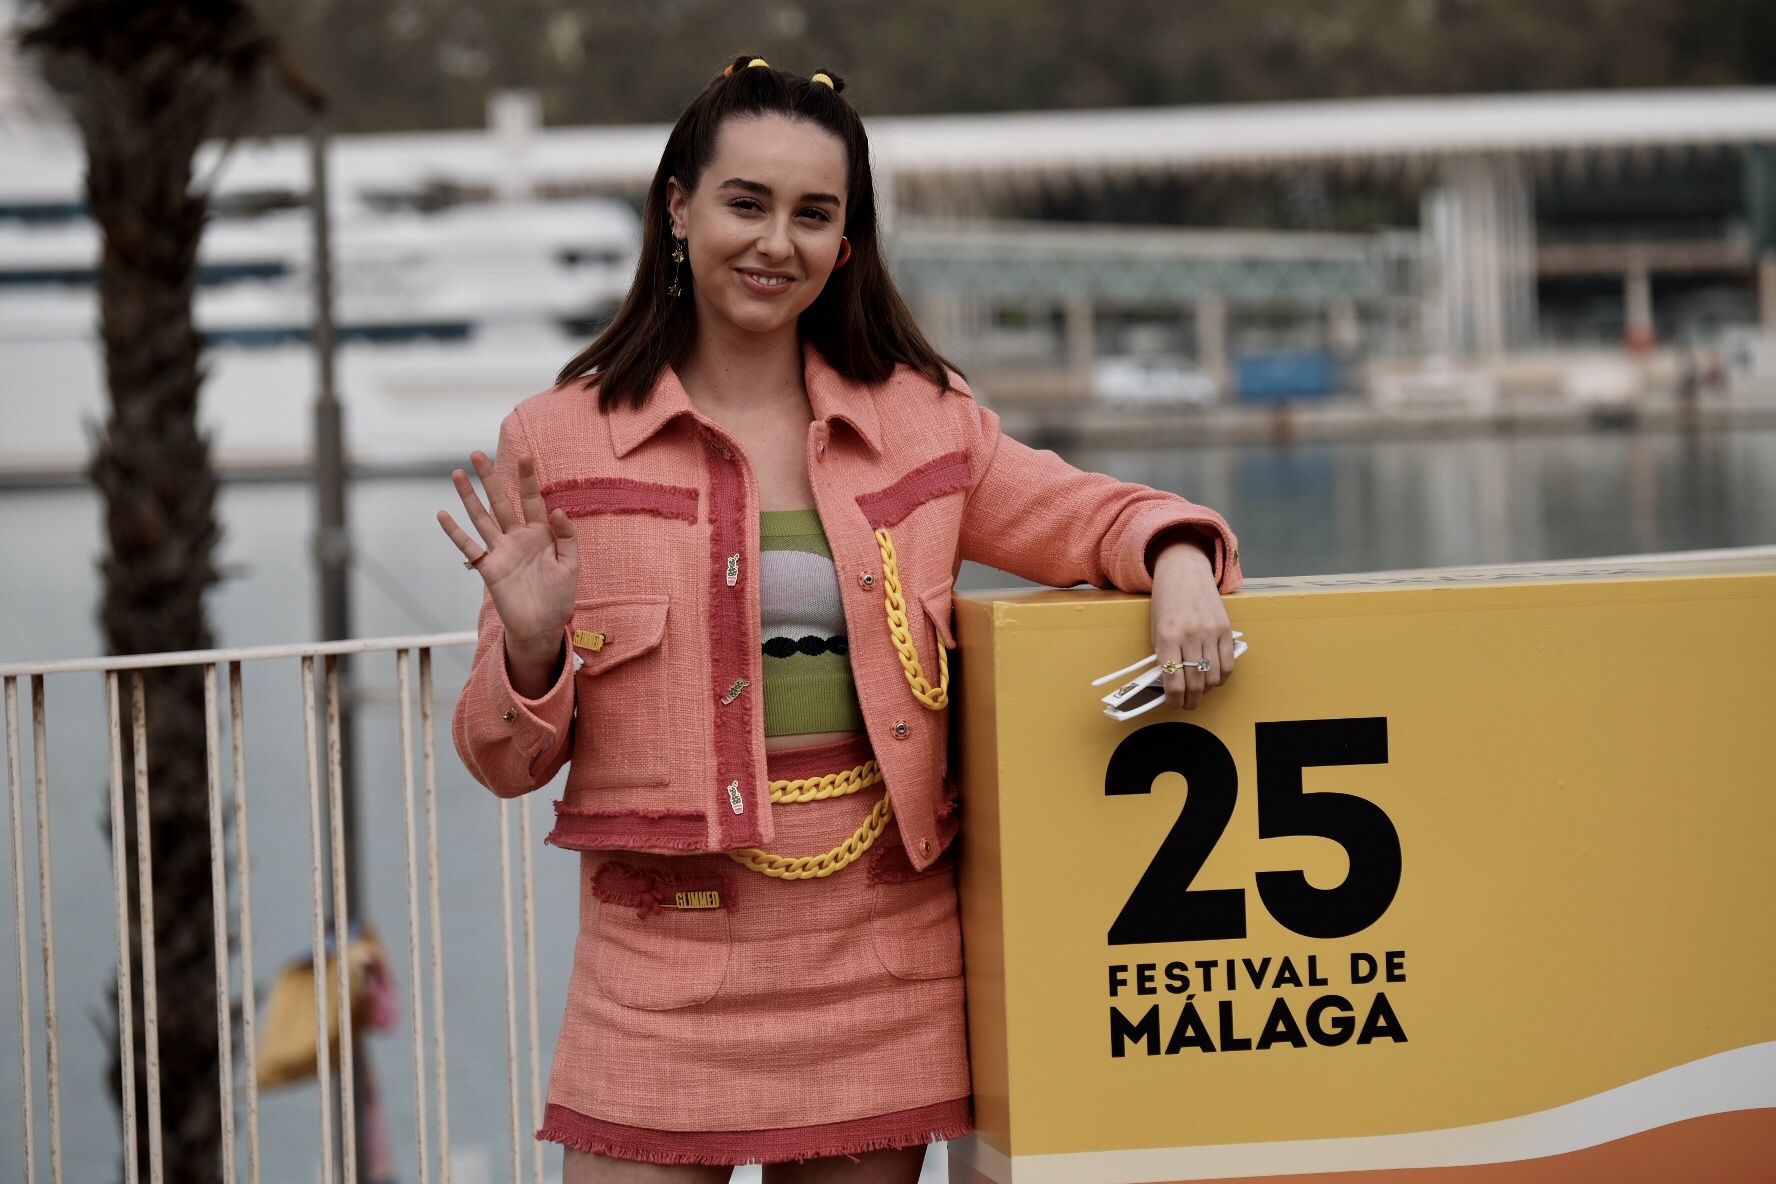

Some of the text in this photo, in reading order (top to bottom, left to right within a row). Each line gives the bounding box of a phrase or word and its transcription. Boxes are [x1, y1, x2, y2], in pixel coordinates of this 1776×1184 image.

[1105, 717, 1402, 945] 25
[1109, 951, 1407, 997] FESTIVAL DE
[1110, 992, 1409, 1058] MÁLAGA
